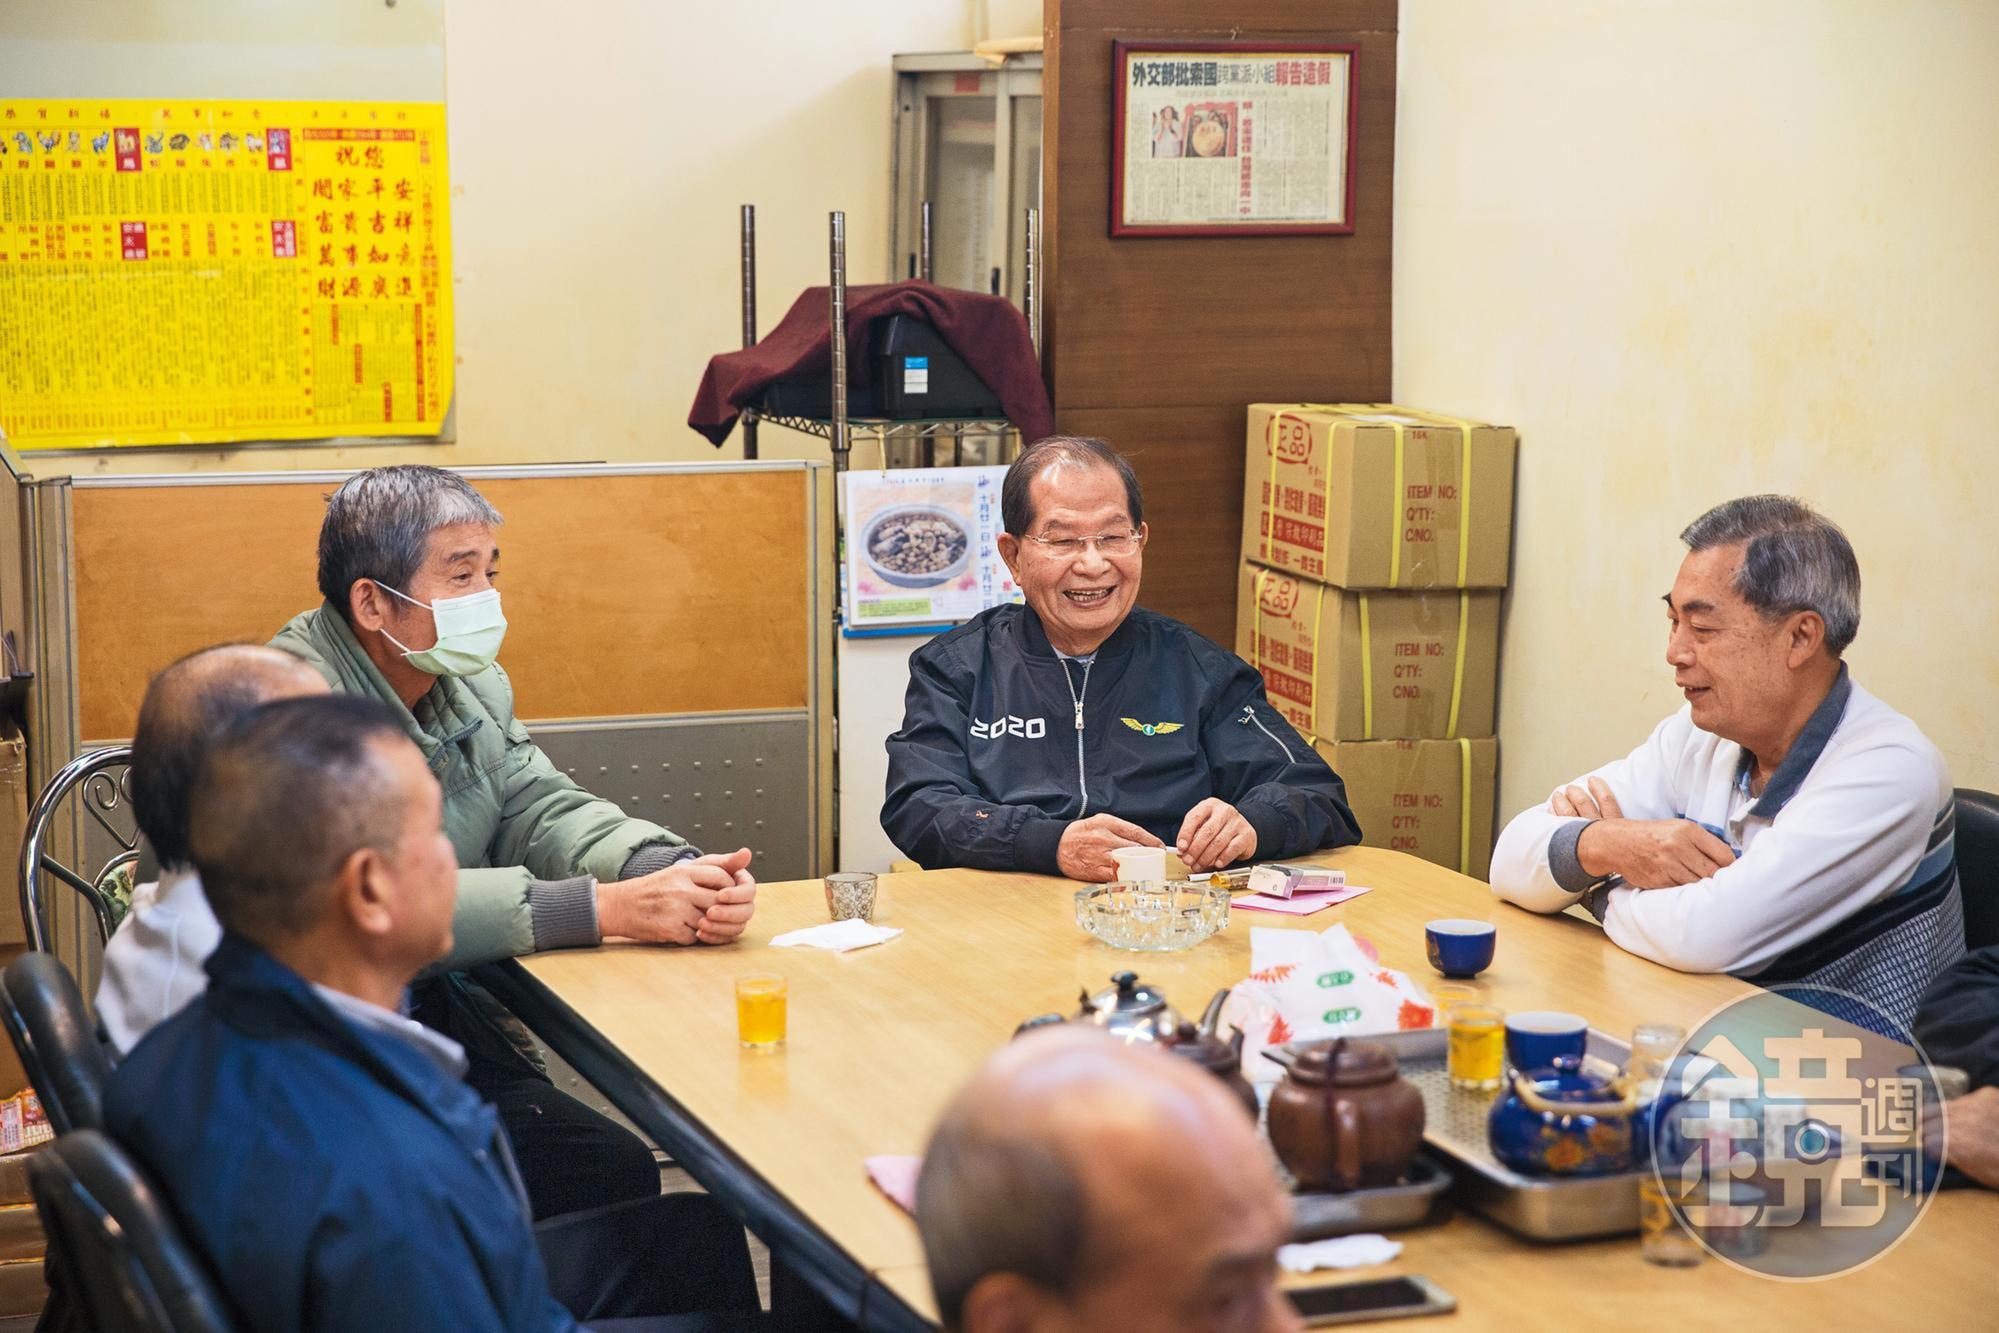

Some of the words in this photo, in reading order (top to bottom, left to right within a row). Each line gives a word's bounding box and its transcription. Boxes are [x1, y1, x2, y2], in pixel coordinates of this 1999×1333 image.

[335, 145, 385, 170] 祝您
[1407, 485, 1432, 499] ITEM
[1438, 485, 1457, 499] NO:
[1406, 507, 1435, 521] Q'TY:
[1394, 642, 1420, 656] ITEM
[1425, 642, 1445, 656] NO:
[1393, 664, 1422, 678] Q'TY:
[970, 715, 1047, 740] 2020
[1392, 793, 1418, 807] ITEM
[1424, 793, 1443, 807] NO:
